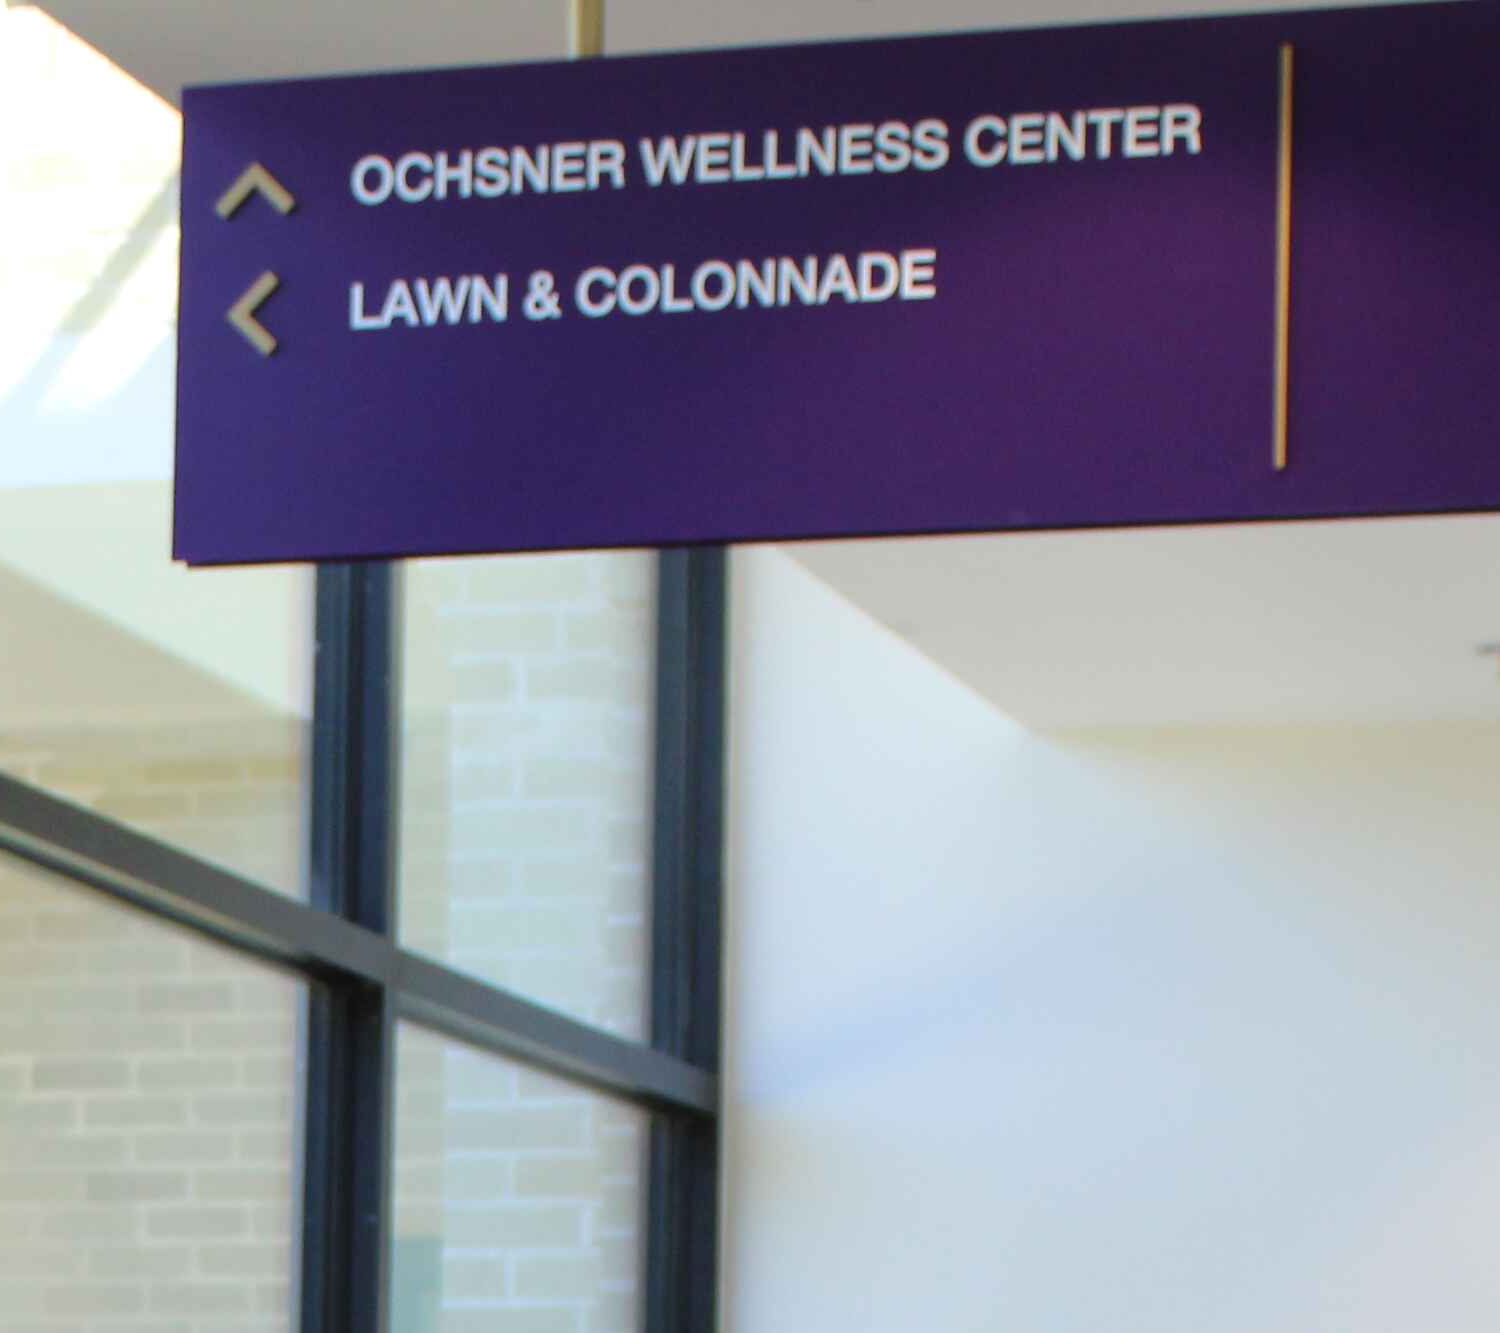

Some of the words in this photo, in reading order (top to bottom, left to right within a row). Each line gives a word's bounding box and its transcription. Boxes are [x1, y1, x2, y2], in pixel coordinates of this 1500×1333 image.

[350, 139, 626, 206] OCHSNER
[639, 117, 951, 188] WELLNESS
[963, 103, 1203, 169] CENTER
[349, 273, 509, 331] LAWN
[522, 269, 562, 321] &
[574, 248, 938, 319] COLONNADE
